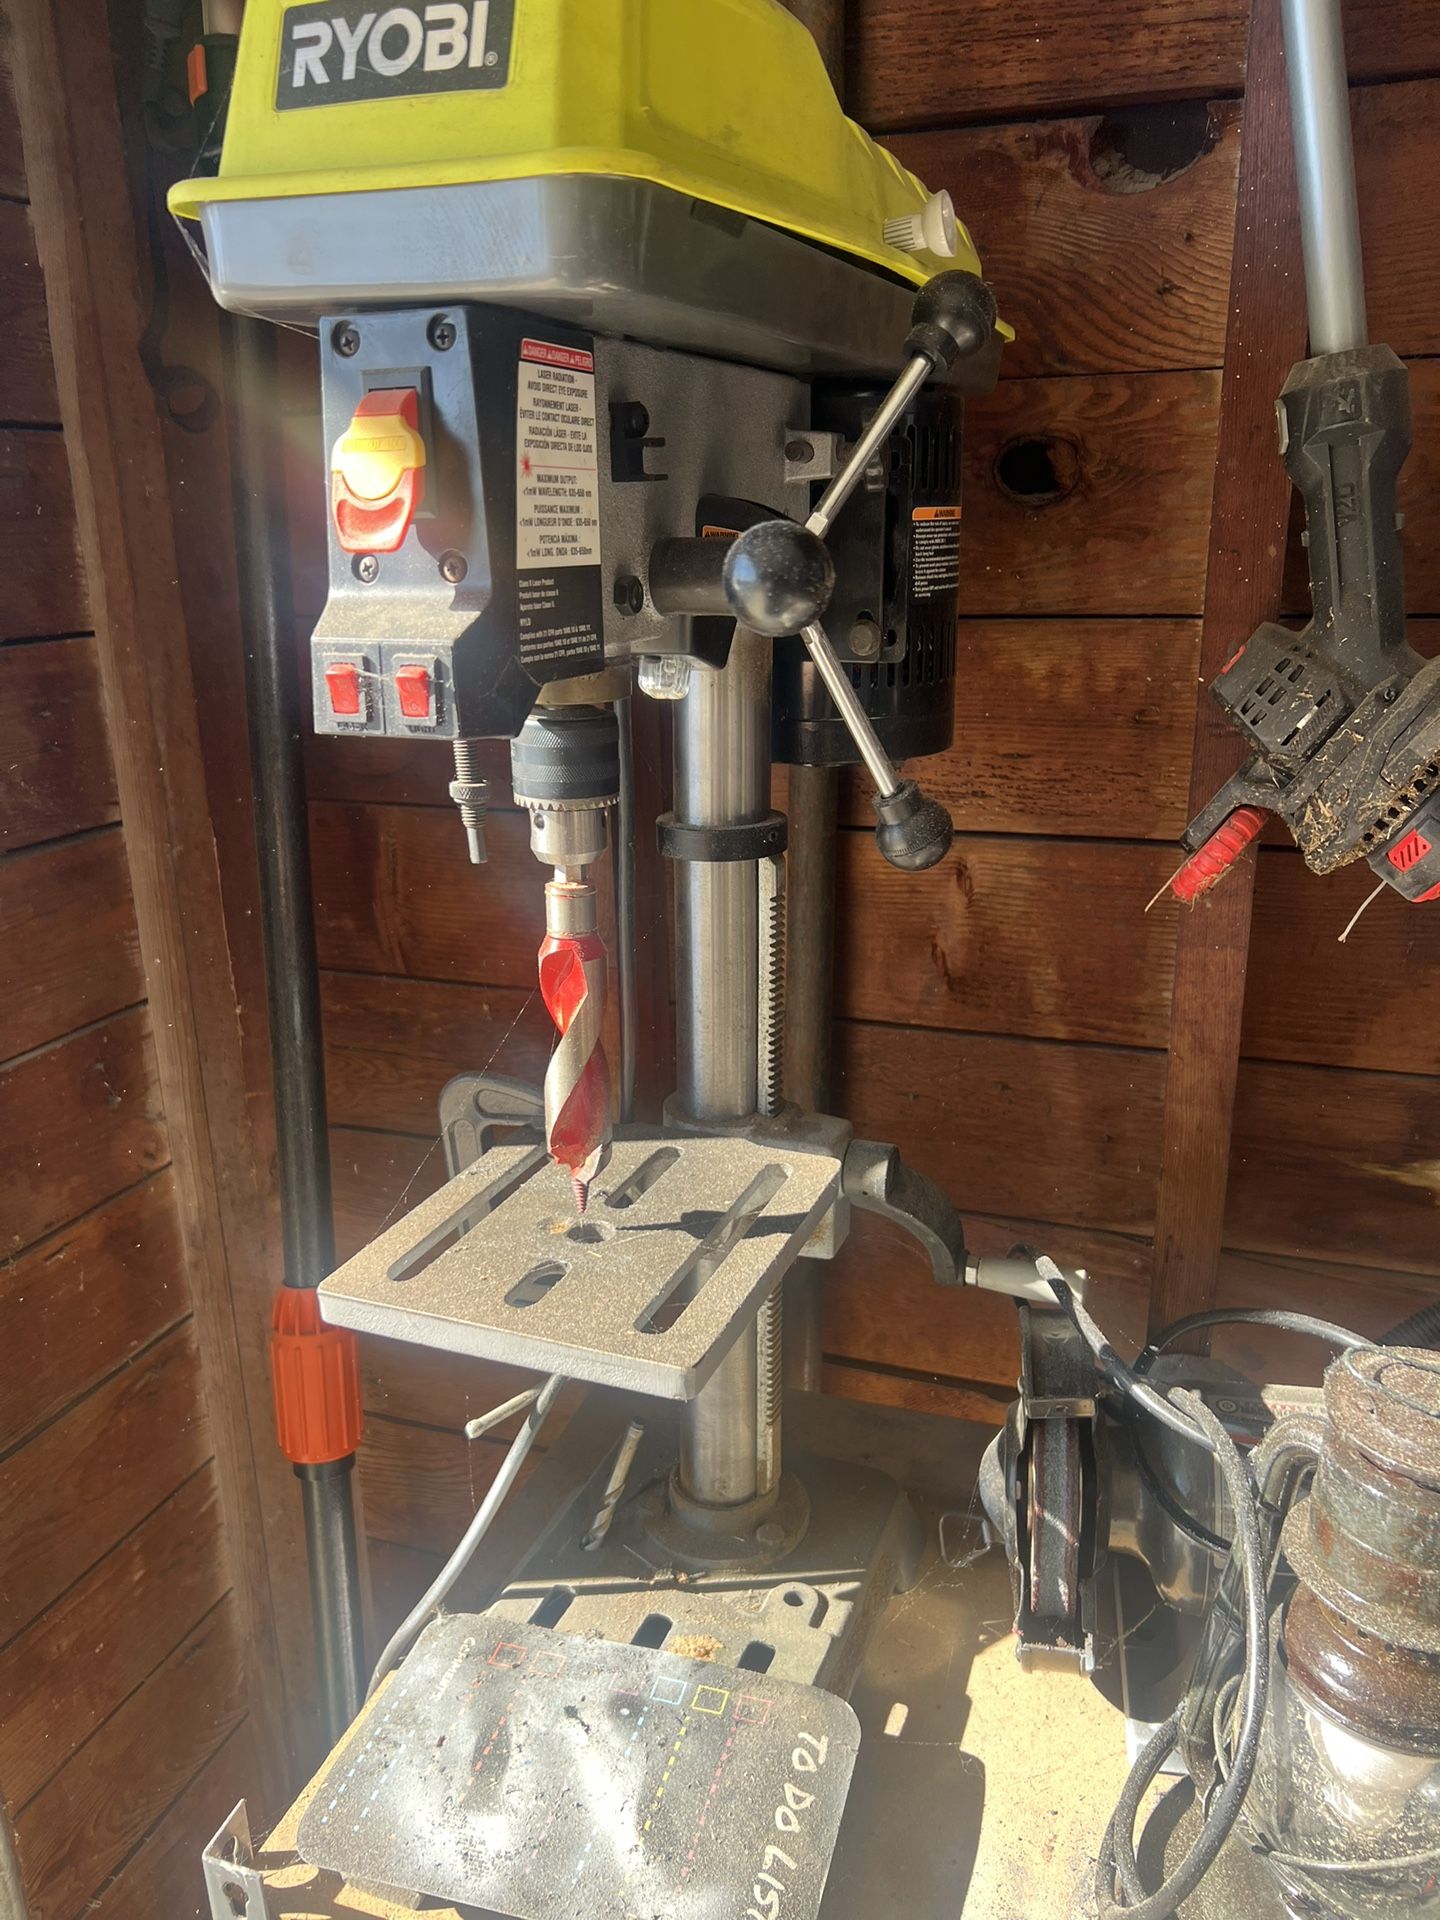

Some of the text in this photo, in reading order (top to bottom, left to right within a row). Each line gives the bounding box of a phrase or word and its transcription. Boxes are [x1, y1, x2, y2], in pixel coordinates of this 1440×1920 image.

[291, 0, 489, 87] RYOBI
[538, 369, 551, 380] LASER
[553, 371, 574, 384] RADIATION
[528, 380, 588, 399] AVOID DIRECT EYE EXPOSURE
[566, 403, 578, 412] LASER
[536, 411, 541, 420] LE
[542, 412, 560, 422] CONTACT
[581, 417, 594, 426] DIRECT
[791, 1731, 829, 1773] TO
[774, 1782, 816, 1834] DO
